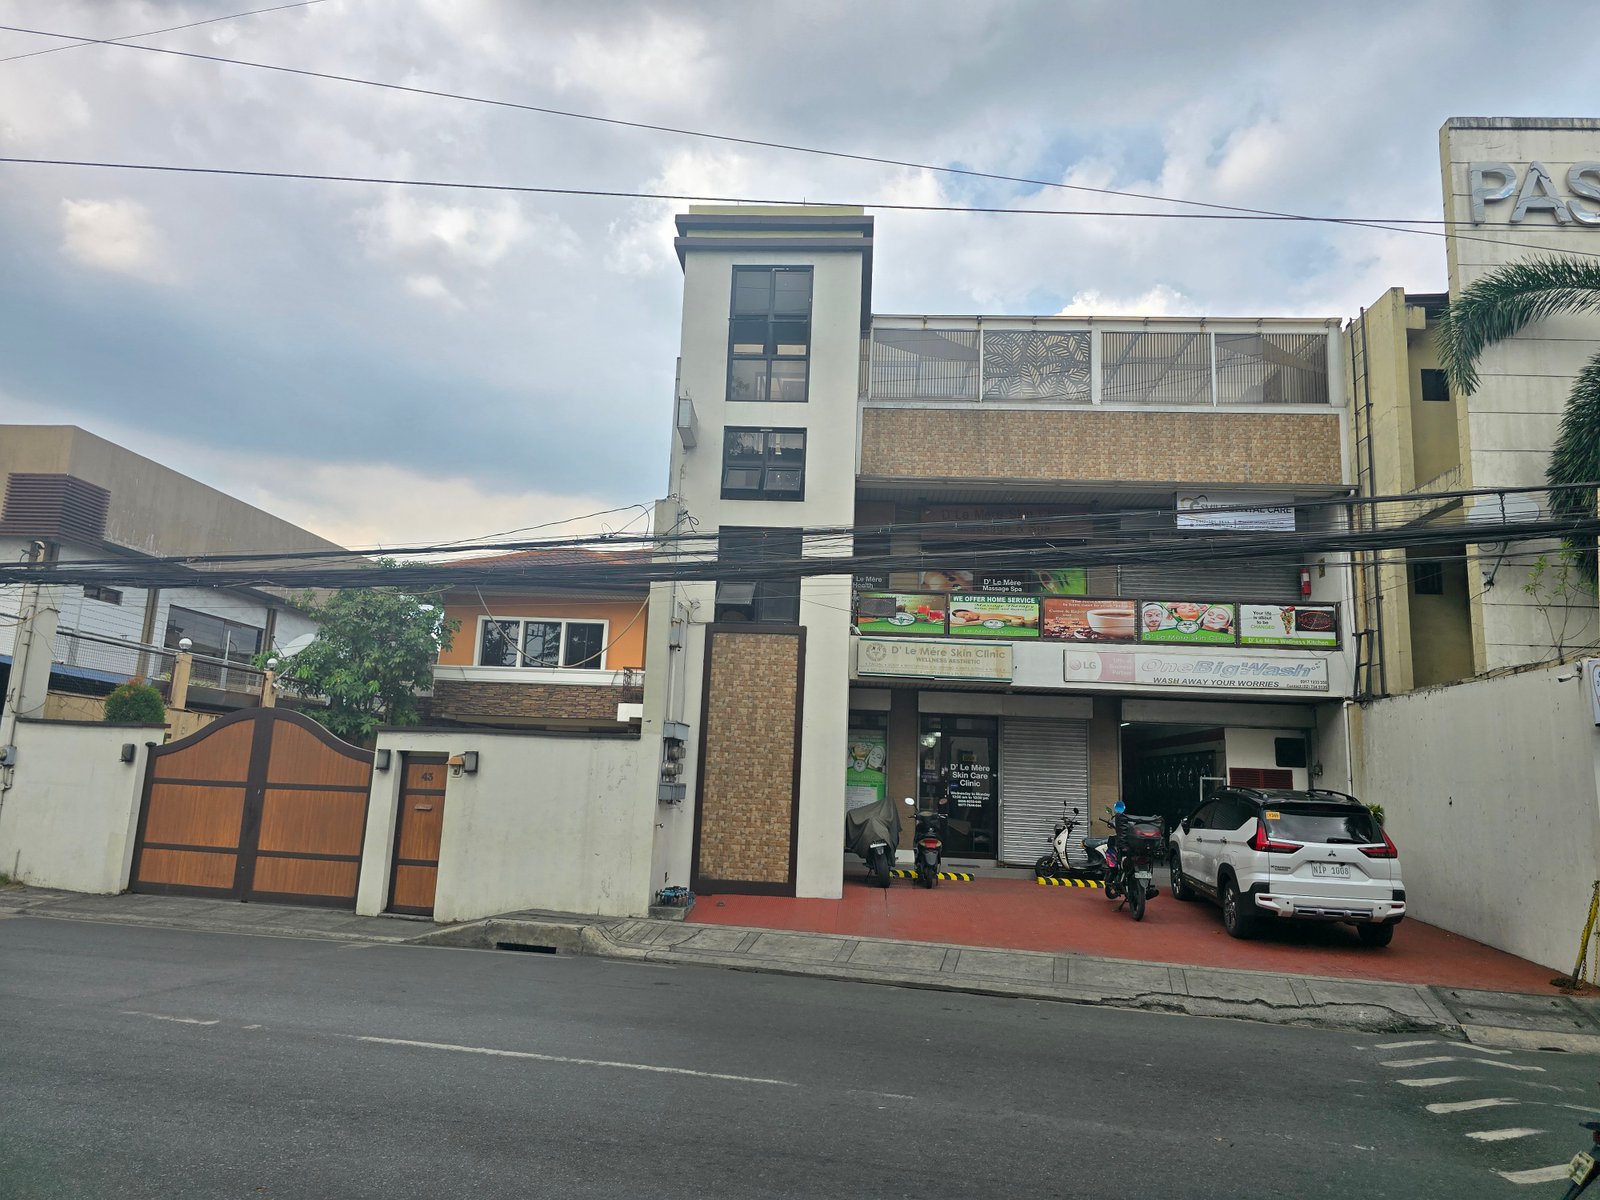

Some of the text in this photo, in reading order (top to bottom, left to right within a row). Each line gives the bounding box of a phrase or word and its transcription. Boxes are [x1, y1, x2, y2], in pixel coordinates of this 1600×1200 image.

[1267, 506, 1292, 514] CARE
[982, 585, 1023, 594] Massage Spa
[905, 646, 917, 655] Le
[951, 648, 972, 658] Skin
[975, 649, 1006, 659] Clinic
[1083, 661, 1097, 669] LG
[1153, 677, 1280, 688] WASH AWAY YOUR WORRIES
[970, 772, 988, 780] Care
[960, 779, 981, 787] Clinic
